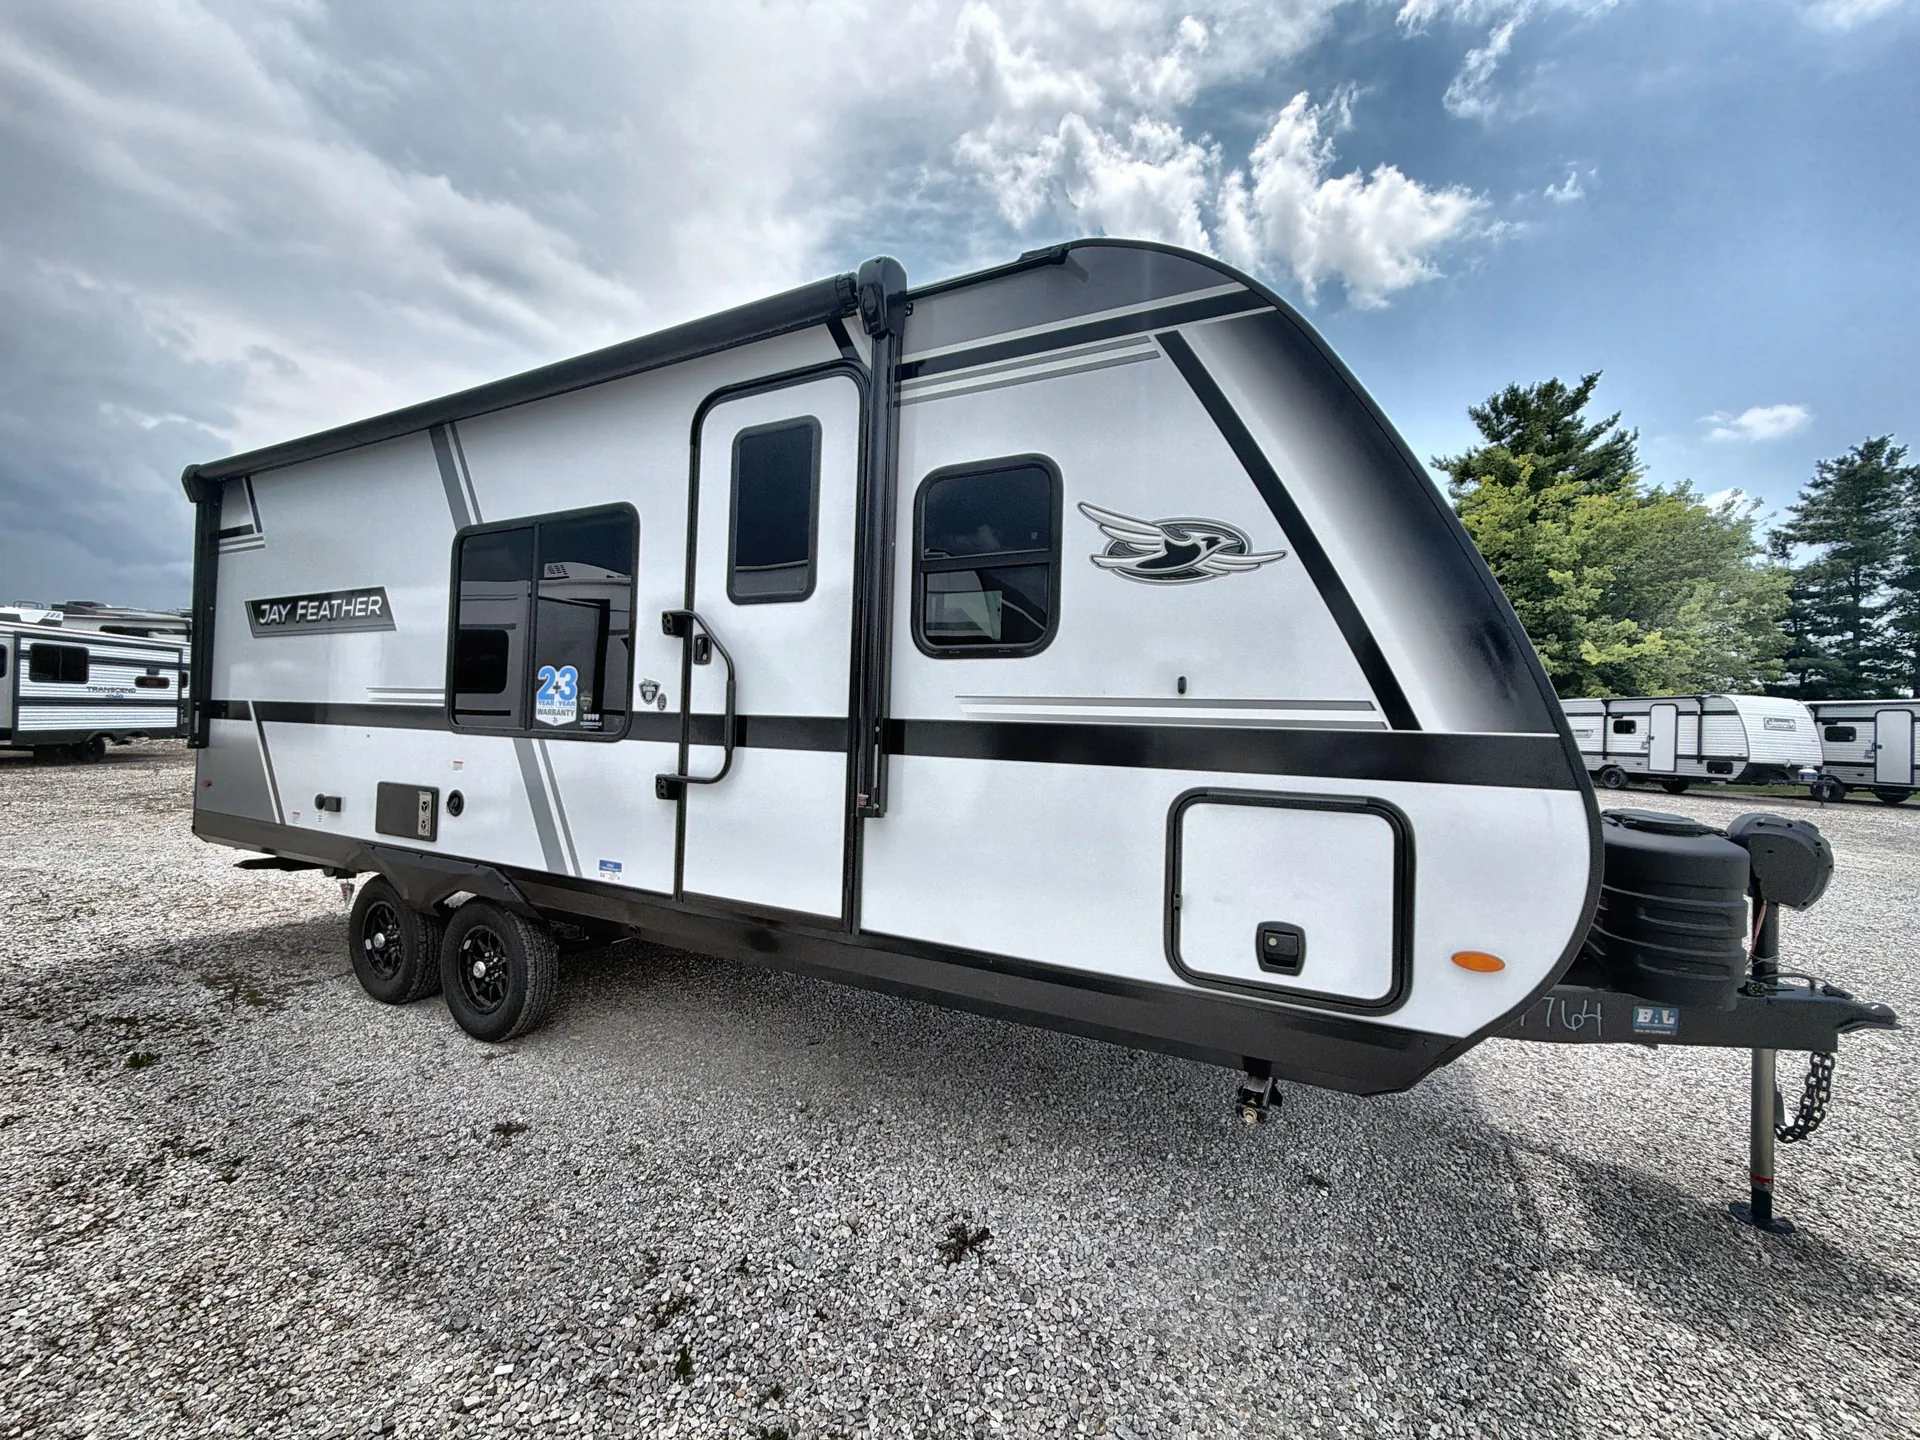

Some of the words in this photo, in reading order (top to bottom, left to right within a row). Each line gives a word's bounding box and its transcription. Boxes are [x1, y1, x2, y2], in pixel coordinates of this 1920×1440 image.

[259, 603, 292, 625] JAY
[296, 596, 382, 621] FEATHER
[86, 686, 137, 694] TRANSCEND
[537, 708, 575, 717] WARRANTY
